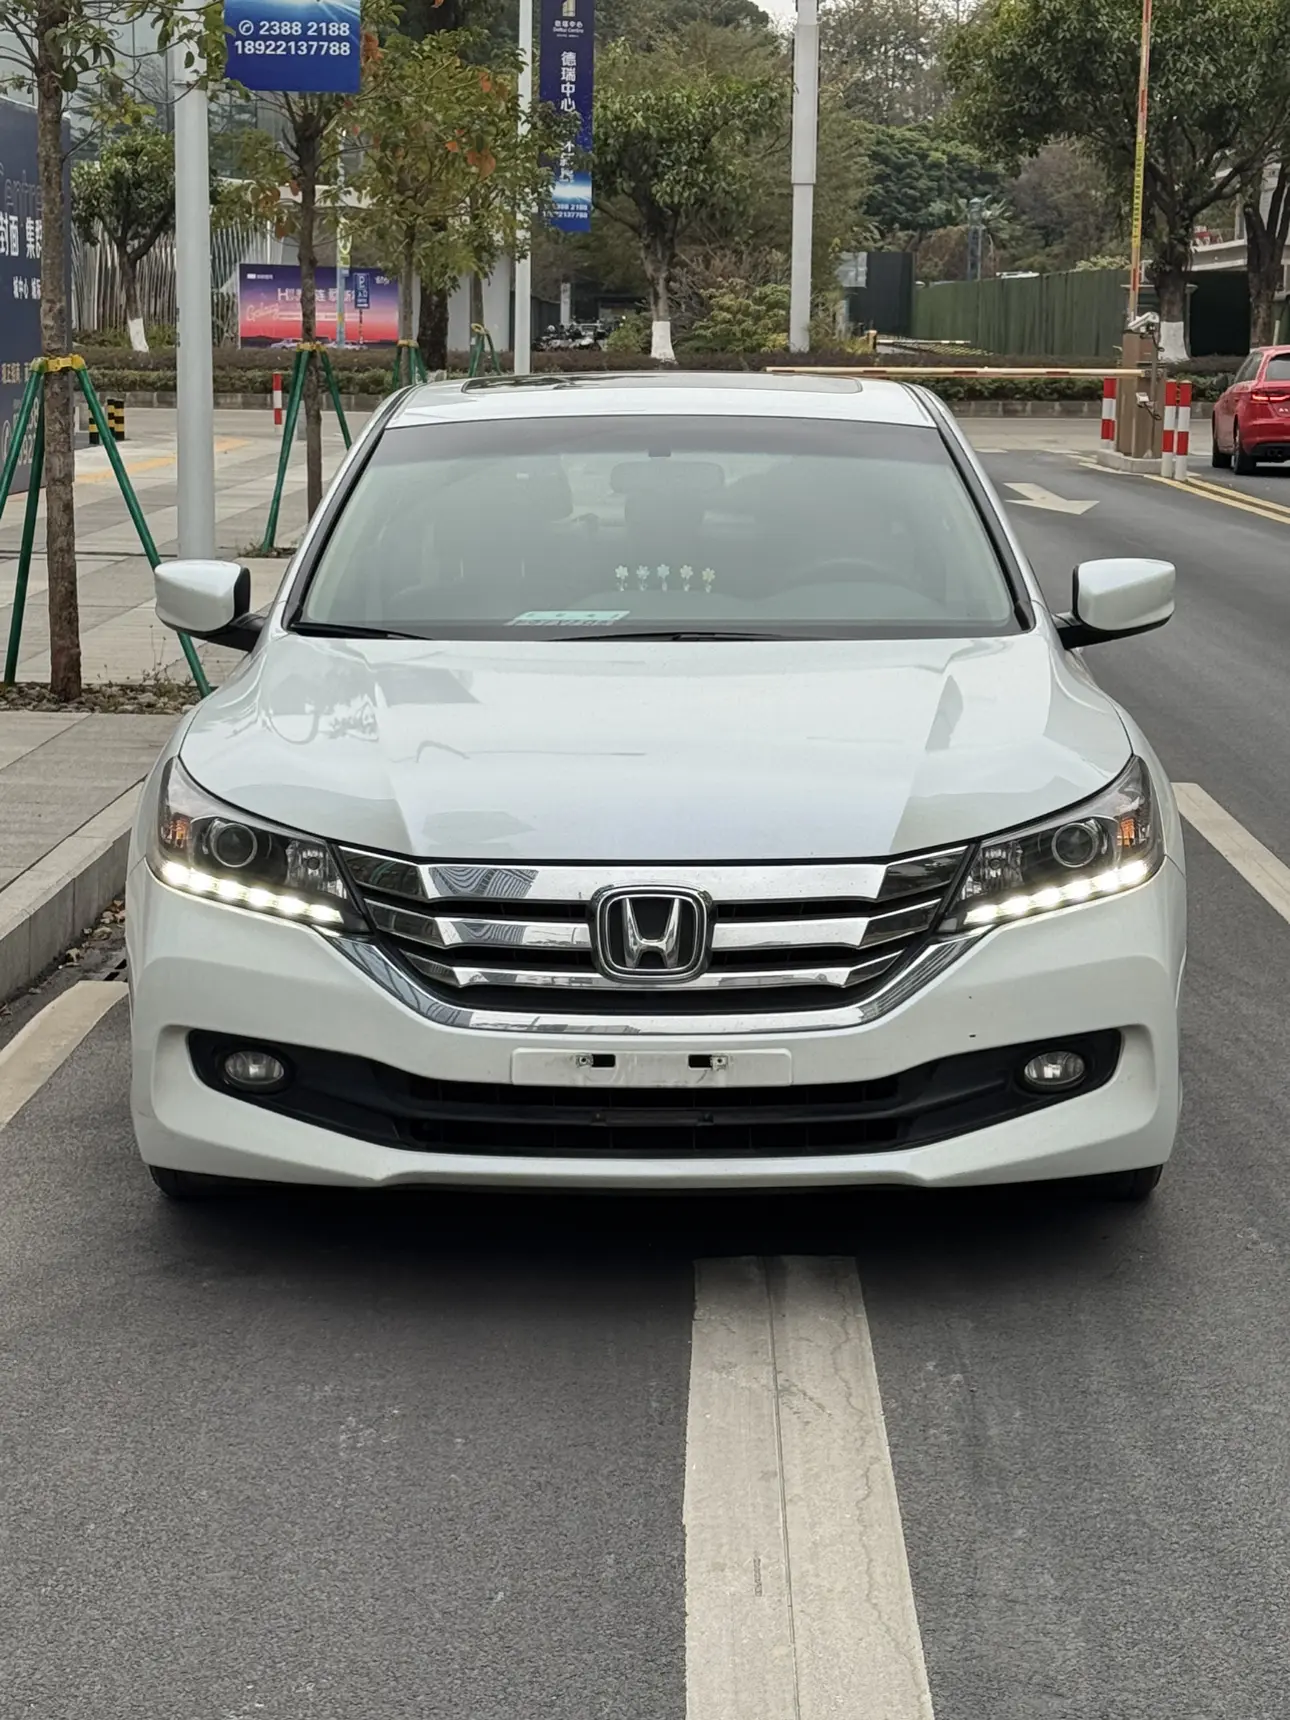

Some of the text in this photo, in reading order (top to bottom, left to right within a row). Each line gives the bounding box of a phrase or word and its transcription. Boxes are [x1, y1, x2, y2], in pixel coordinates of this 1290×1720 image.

[259, 21, 350, 37] 2388 2188
[234, 40, 351, 56] 18922137788
[560, 51, 577, 112] 德瑞中心
